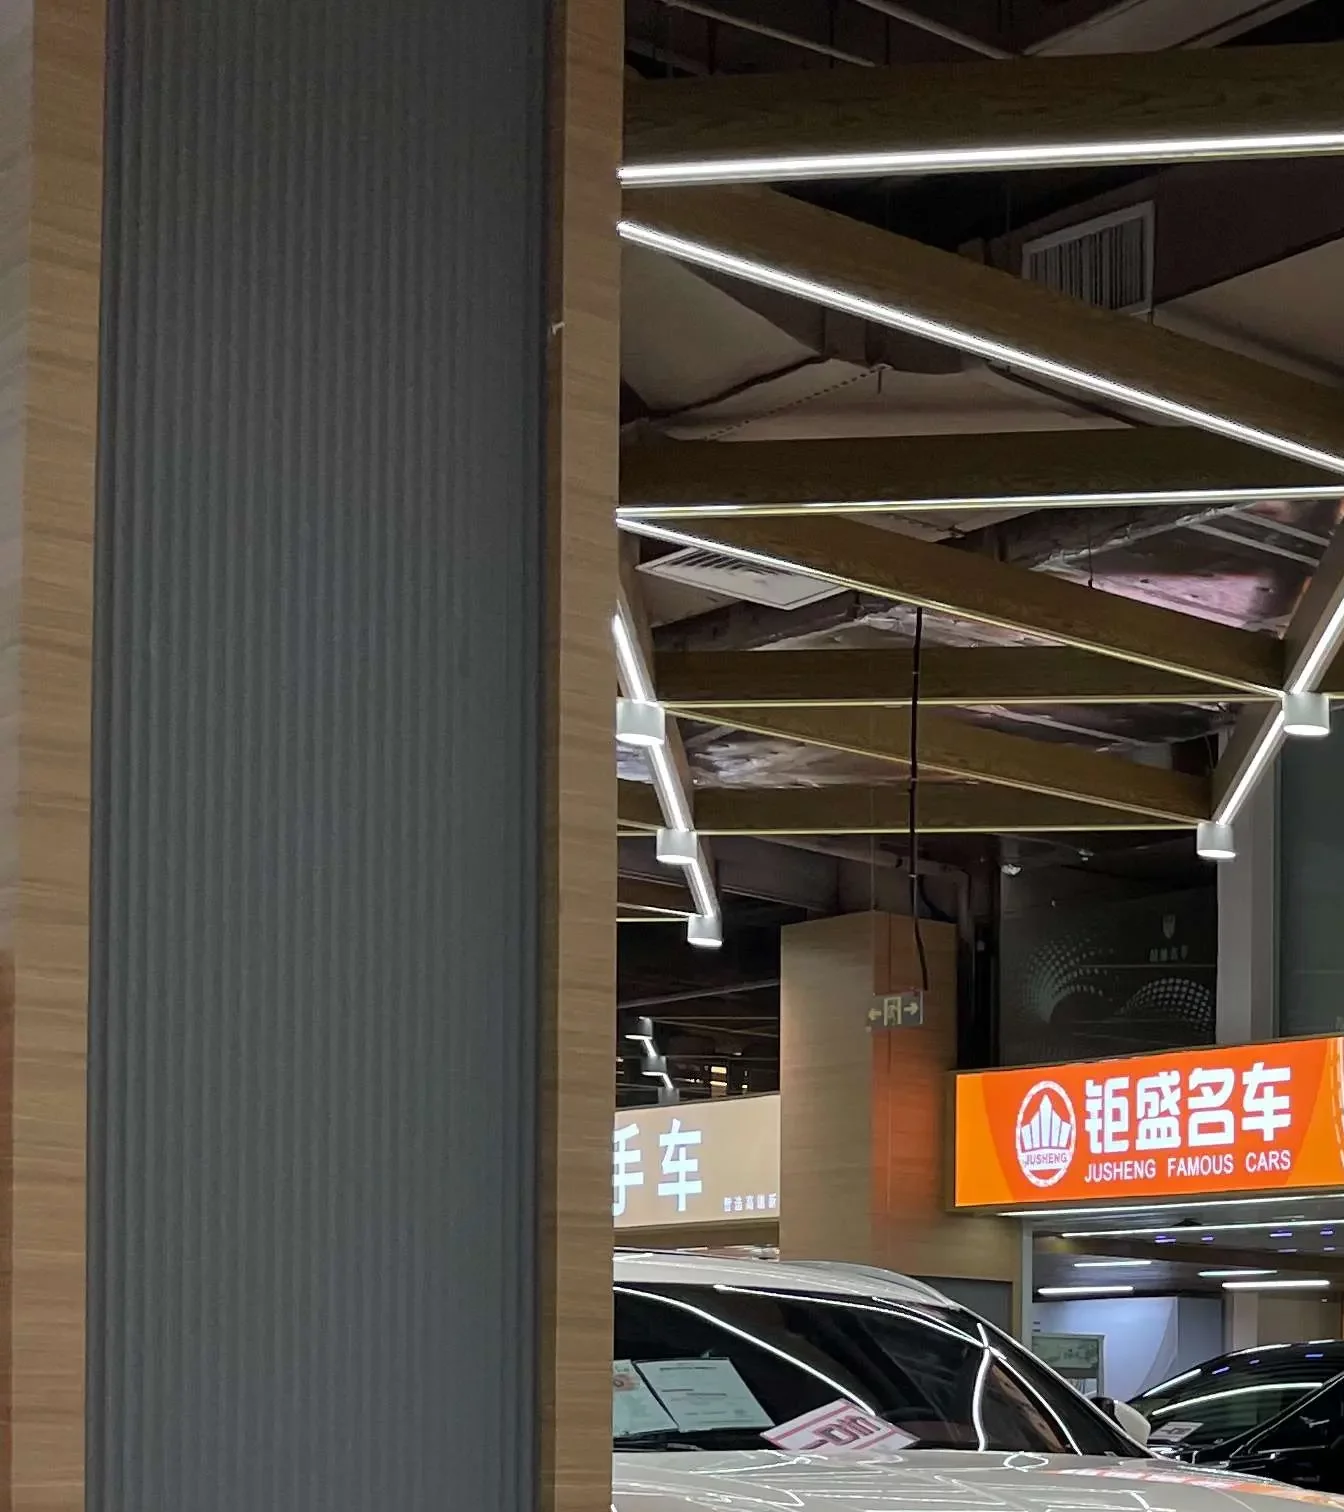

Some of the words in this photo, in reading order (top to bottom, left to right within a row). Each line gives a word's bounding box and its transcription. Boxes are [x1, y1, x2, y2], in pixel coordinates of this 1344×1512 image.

[1084, 1062, 1291, 1154] 钜盛名车
[1024, 1152, 1068, 1166] JUSHENG
[1084, 1158, 1156, 1183] JUSHENG
[1167, 1154, 1234, 1178] FAMOUS
[1245, 1150, 1291, 1172] CARS
